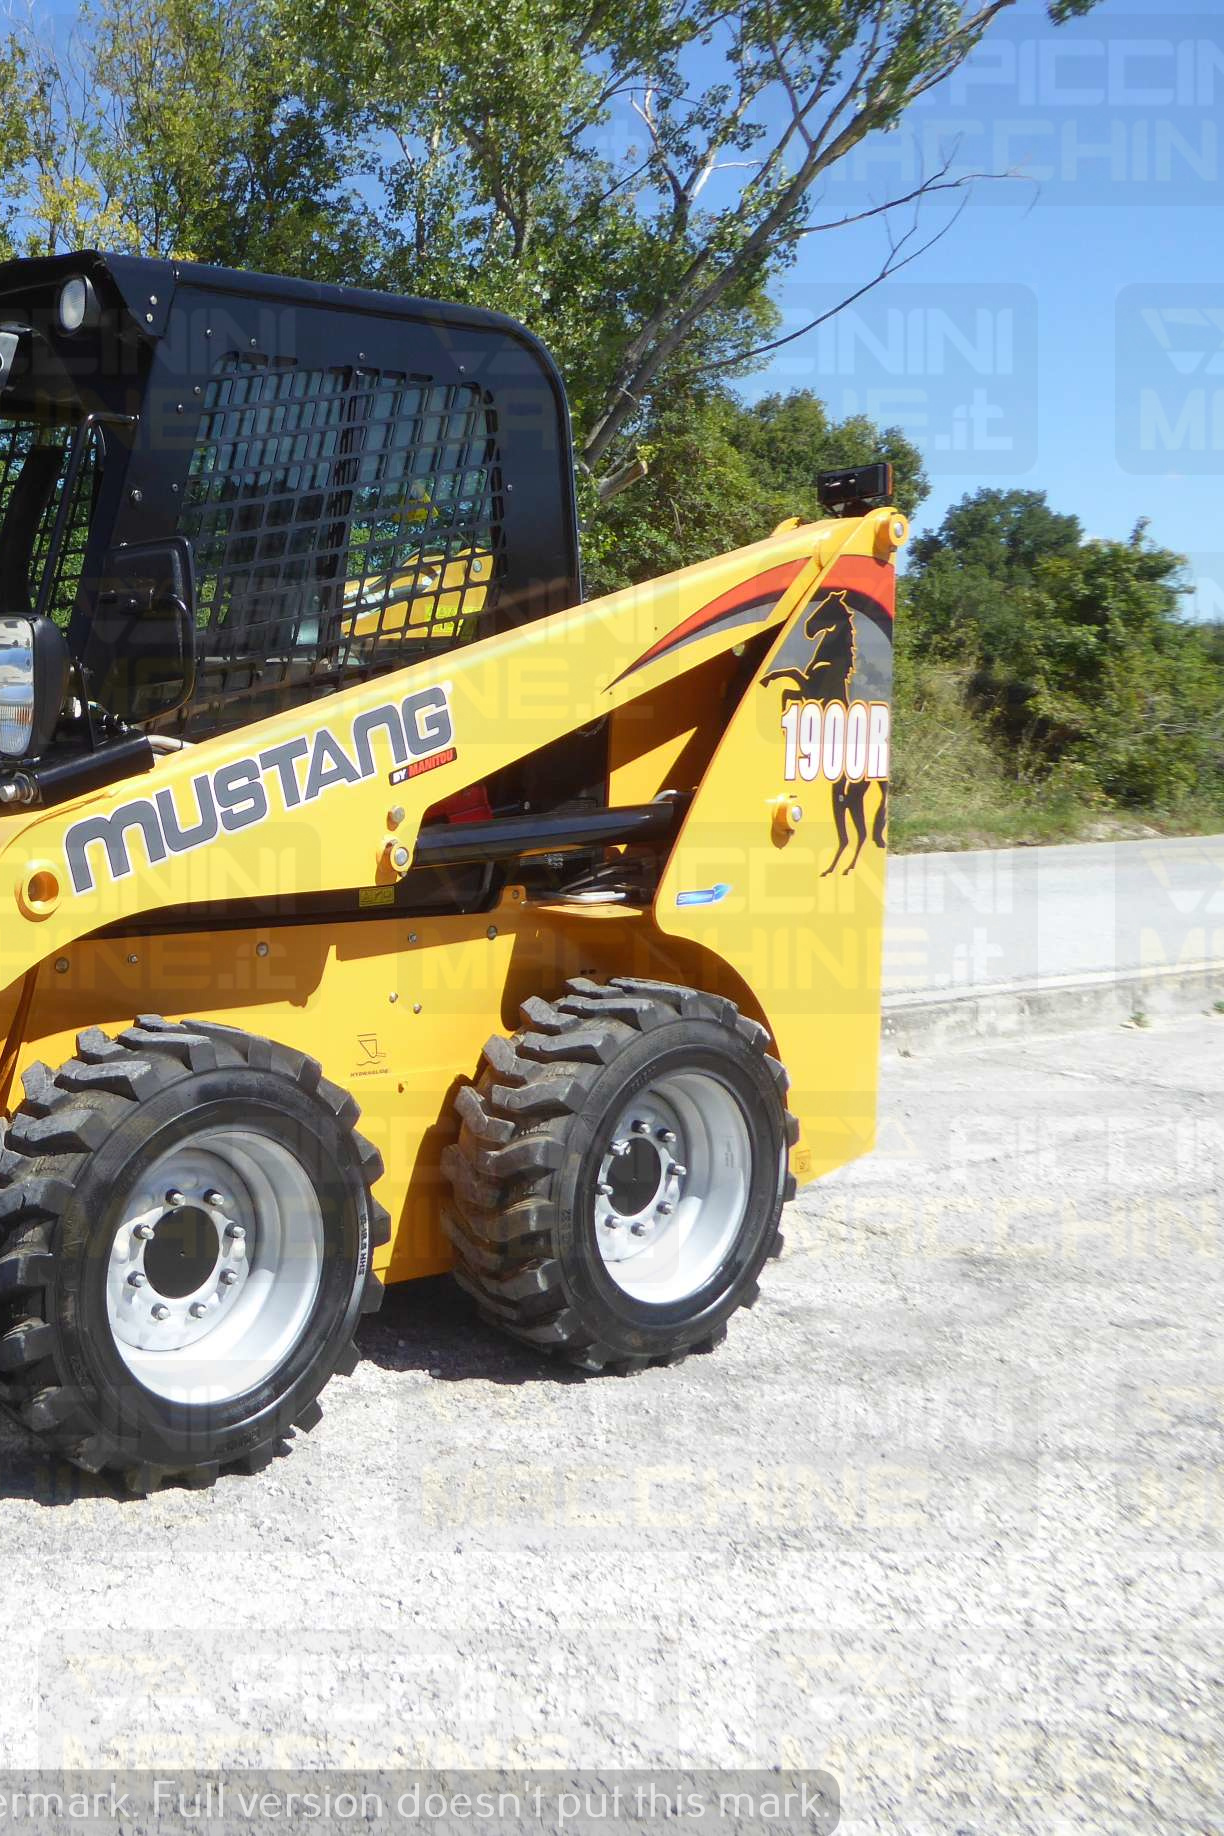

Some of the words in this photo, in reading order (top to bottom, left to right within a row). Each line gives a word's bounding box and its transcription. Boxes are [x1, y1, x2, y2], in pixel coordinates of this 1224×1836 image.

[408, 749, 454, 777] MANITOU
[780, 701, 889, 782] 1900R
[64, 683, 455, 895] MUSTANG
